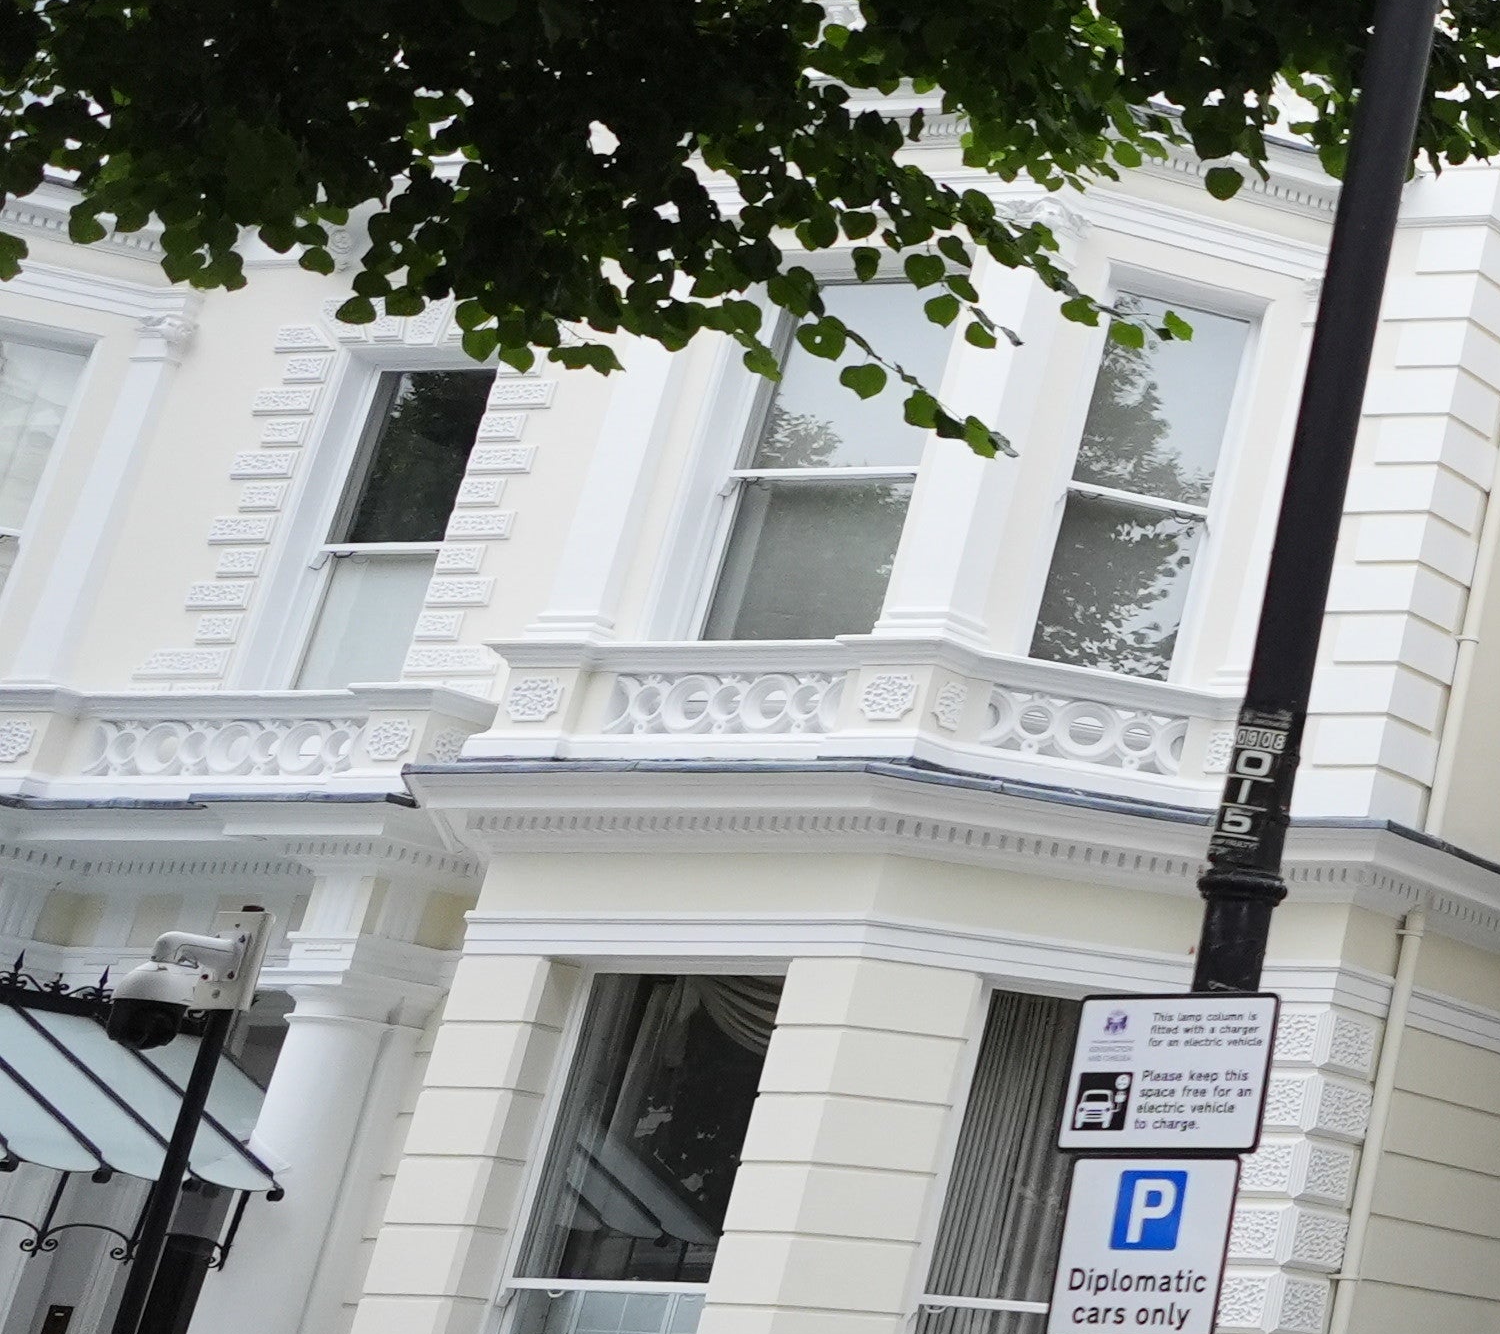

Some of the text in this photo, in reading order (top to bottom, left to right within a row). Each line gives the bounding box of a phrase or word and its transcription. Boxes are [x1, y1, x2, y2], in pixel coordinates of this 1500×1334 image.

[1152, 1012, 1258, 1024] This lamp column is
[1150, 1025, 1179, 1035] fitted
[1183, 1025, 1205, 1035] with
[1219, 1025, 1260, 1036] charger
[1148, 1037, 1163, 1047] for
[1184, 1037, 1223, 1047] electric
[1227, 1037, 1263, 1047] vehicle
[1141, 1070, 1249, 1083] Please keep this
[1138, 1085, 1252, 1100] space free for an
[1136, 1101, 1236, 1114] electric vehicle
[1134, 1118, 1146, 1130] to
[1125, 1178, 1177, 1244] P
[1068, 1268, 1207, 1296] Diplomatic
[1072, 1302, 1191, 1331] cars only
